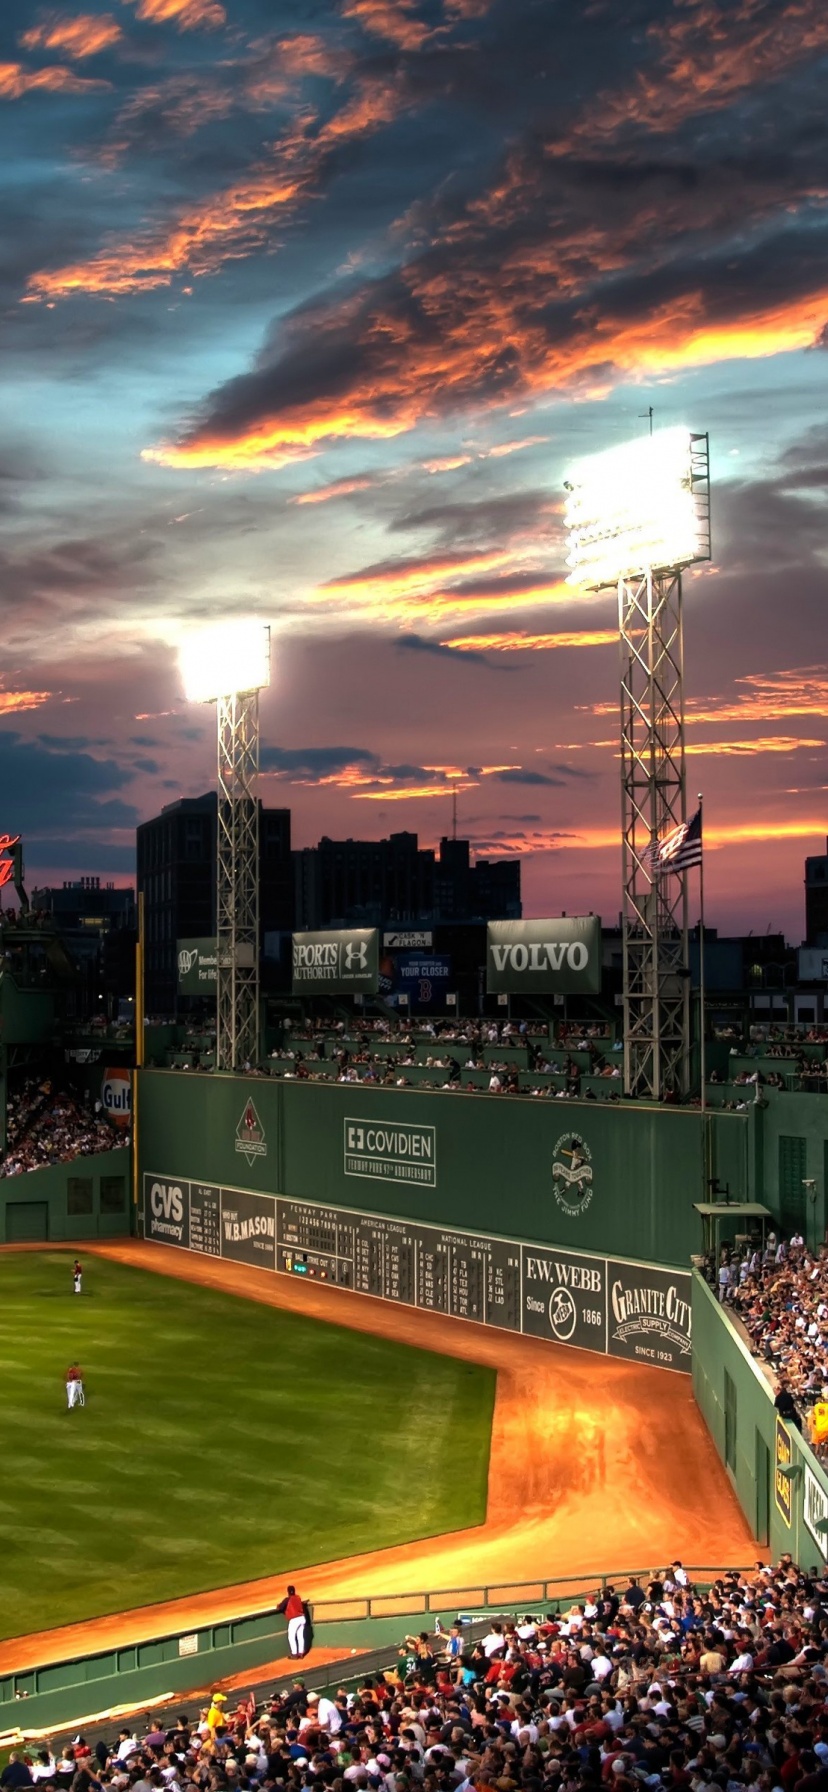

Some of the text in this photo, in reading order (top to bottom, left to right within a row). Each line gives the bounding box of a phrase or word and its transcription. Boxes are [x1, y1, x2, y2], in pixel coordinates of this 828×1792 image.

[293, 943, 338, 967] SPORTS
[490, 941, 589, 972] VOLVO
[401, 966, 449, 977] YOUR CLOSER
[366, 1129, 432, 1158] COVIDIEN
[552, 1132, 593, 1161] BOSTON RED SOX
[151, 1182, 183, 1222] CVS
[291, 1205, 337, 1221] FENWAY PARK
[561, 1205, 580, 1217] JIMMY
[580, 1189, 594, 1213] FUND
[151, 1218, 184, 1241] pharmacy
[360, 1218, 406, 1234] AMERICAN LEAGUE
[441, 1234, 492, 1251] NATIONAL LEAGUE
[320, 1258, 328, 1267] OUT
[495, 1276, 504, 1286] STL
[554, 1262, 602, 1292] WEBB
[526, 1296, 545, 1314] Since
[582, 1308, 602, 1327] 1866
[612, 1279, 665, 1324] GRANITE
[642, 1318, 668, 1331] SUPPLY
[668, 1330, 690, 1347] COMPANY
[635, 1345, 673, 1362] SINCE 1923
[406, 1662, 416, 1674] 34
